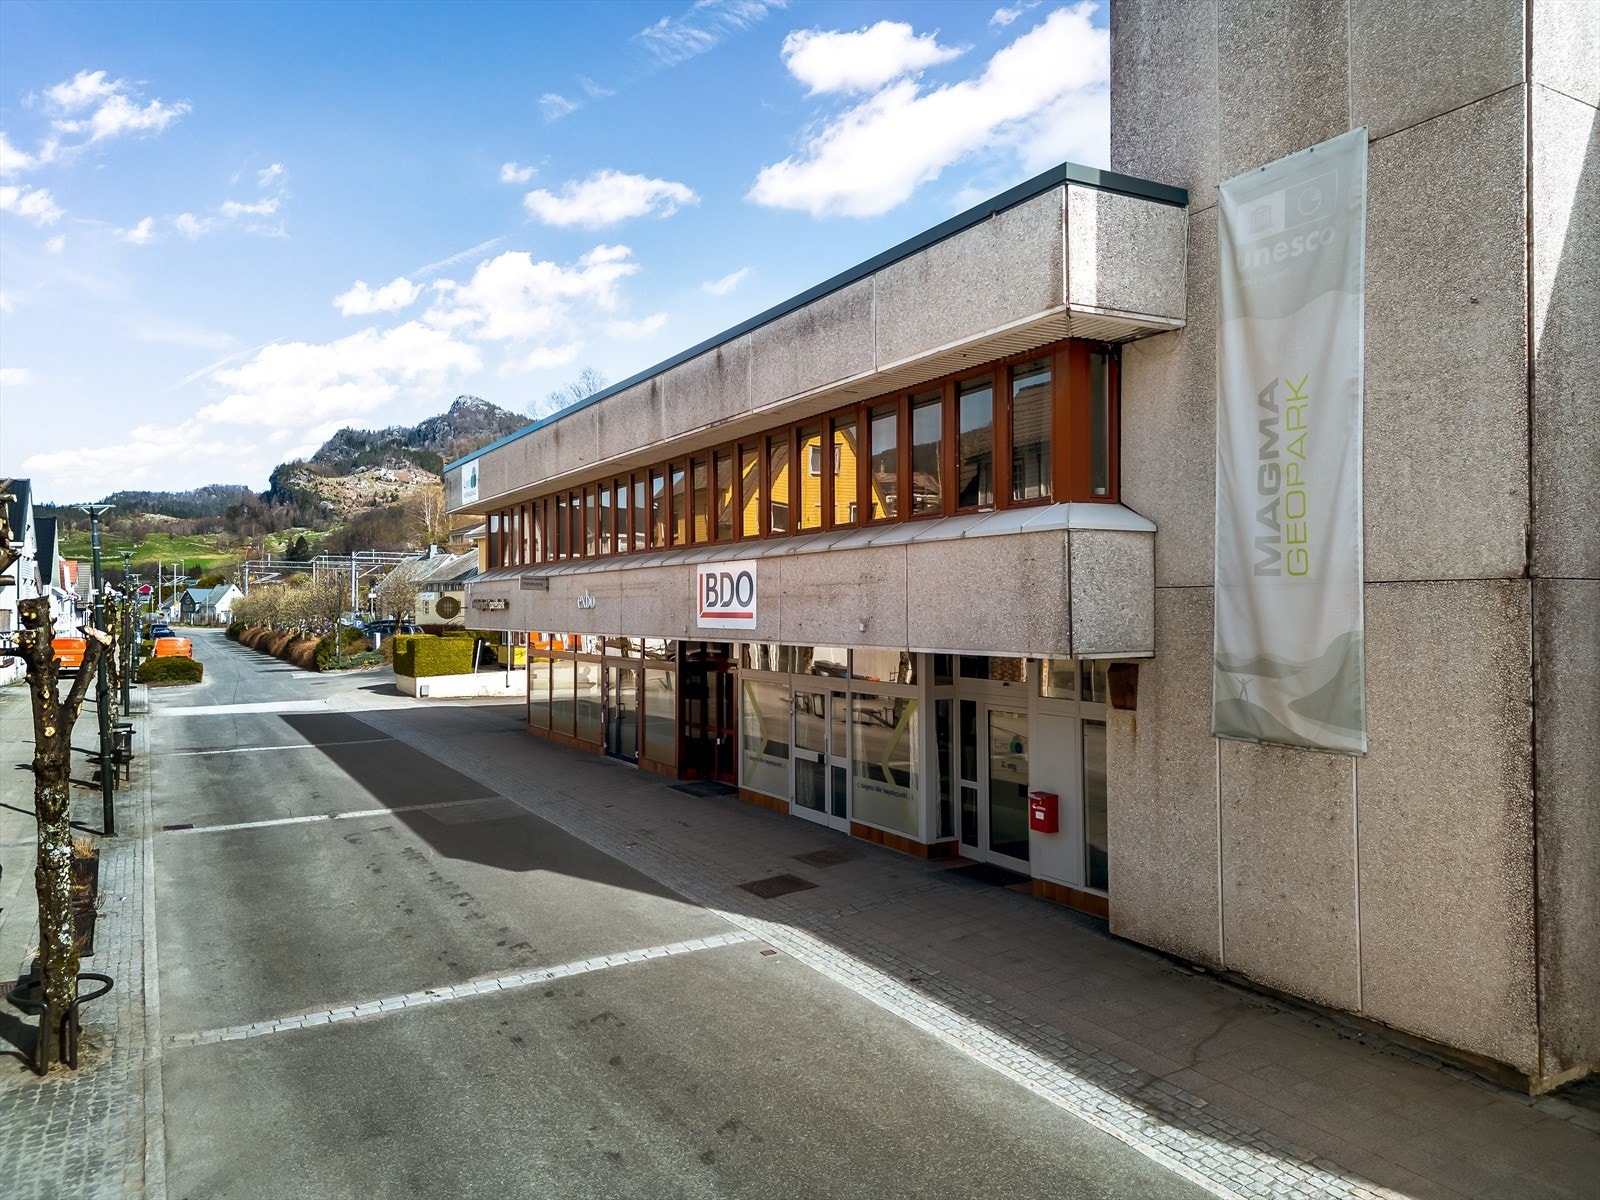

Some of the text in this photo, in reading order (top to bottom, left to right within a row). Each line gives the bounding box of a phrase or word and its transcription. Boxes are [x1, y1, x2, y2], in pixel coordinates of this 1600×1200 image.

[1236, 225, 1336, 271] unesco
[1254, 376, 1281, 577] MAGMA
[1285, 373, 1309, 577] GEOPARK
[577, 590, 596, 609] exbo
[705, 570, 754, 608] BDO
